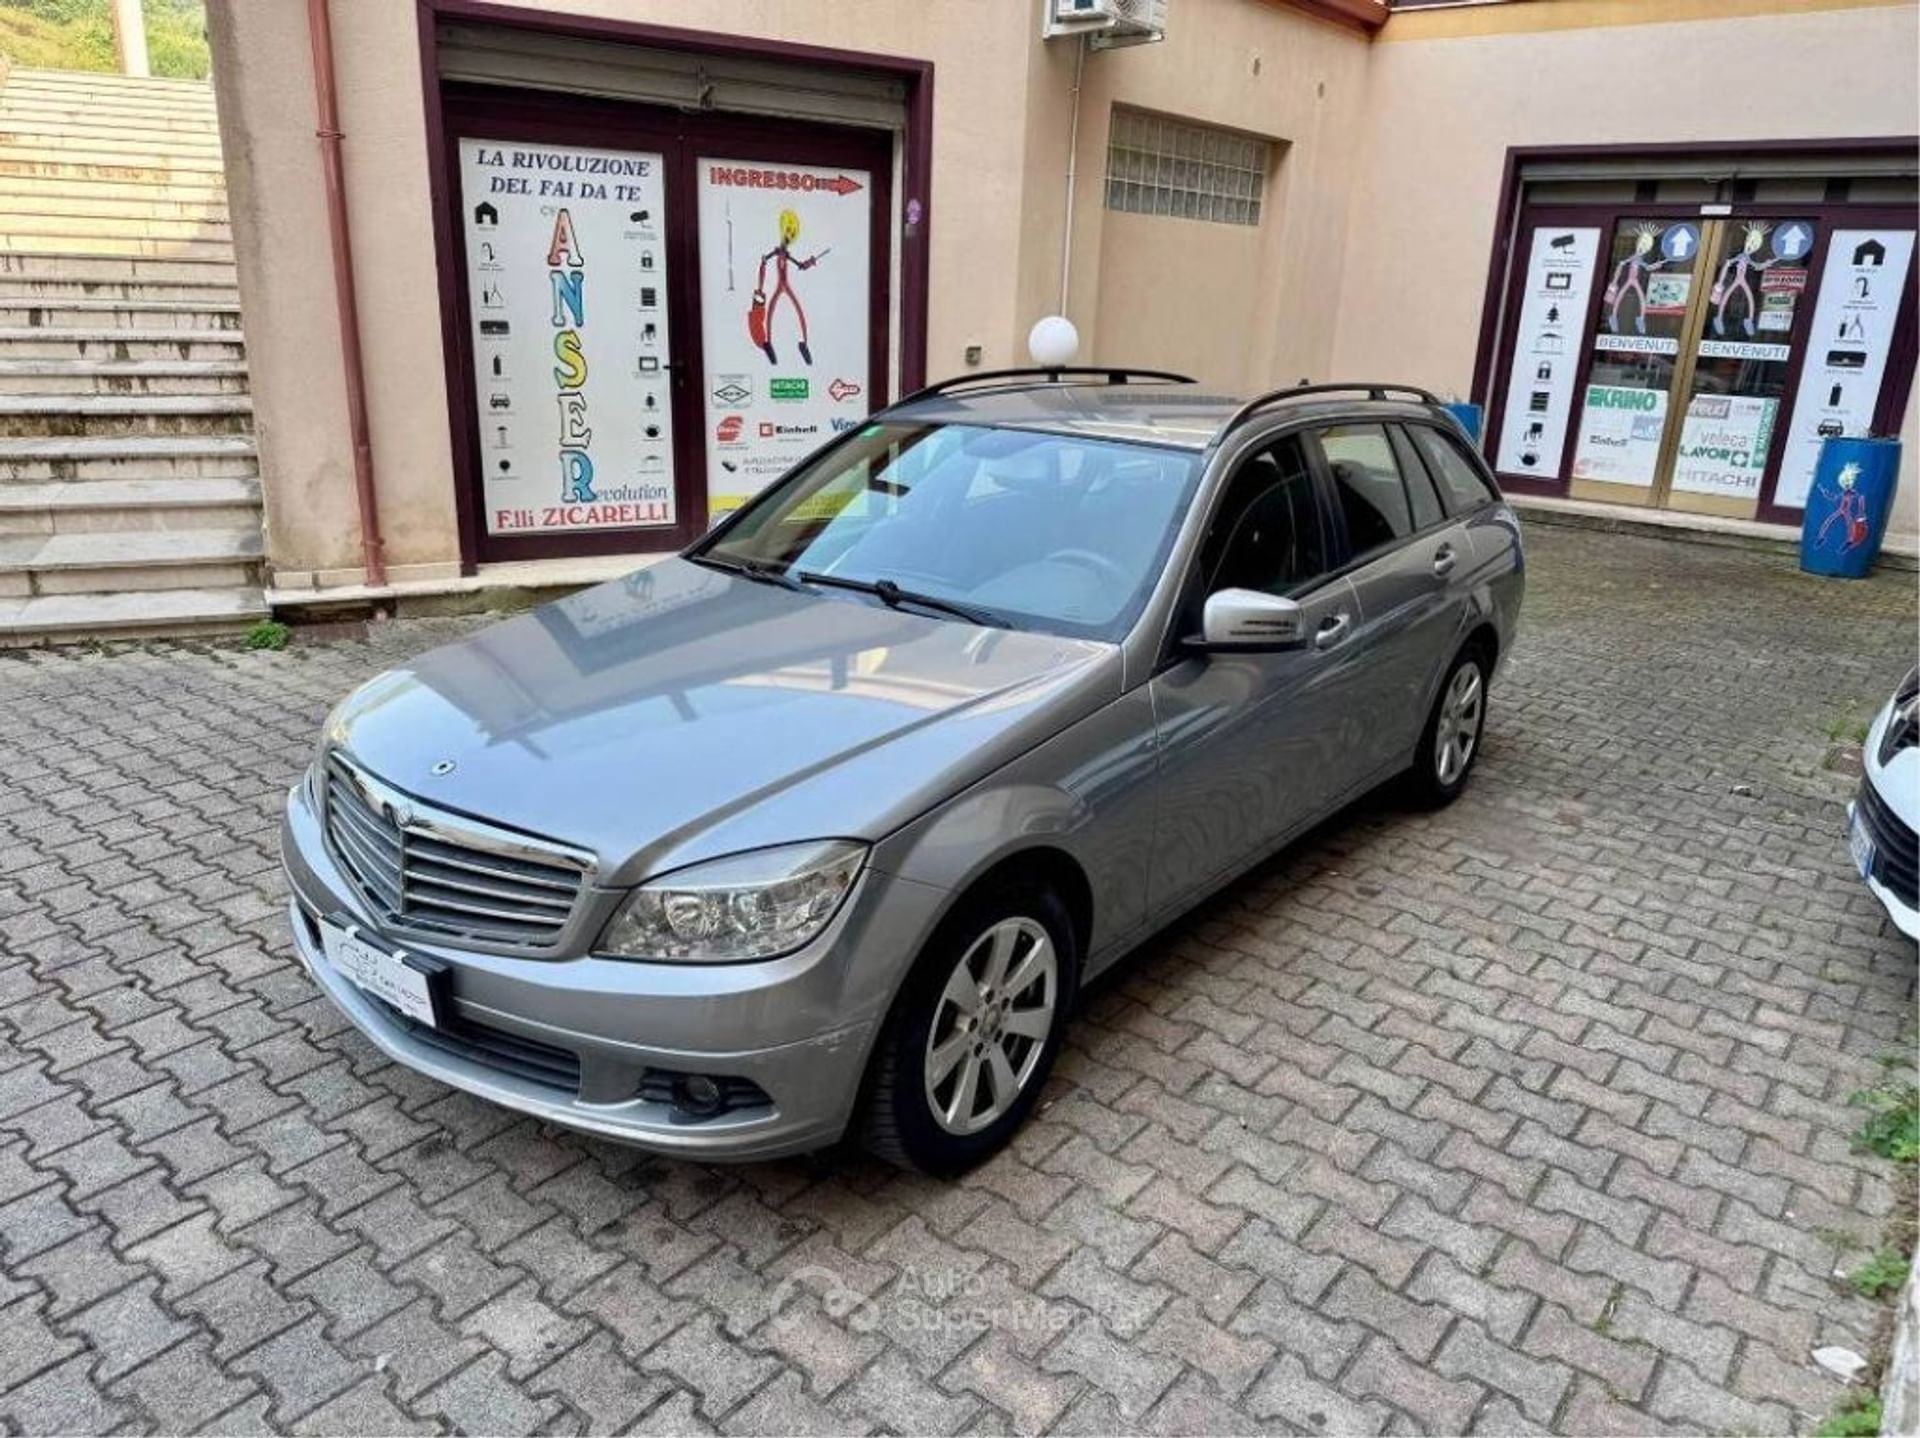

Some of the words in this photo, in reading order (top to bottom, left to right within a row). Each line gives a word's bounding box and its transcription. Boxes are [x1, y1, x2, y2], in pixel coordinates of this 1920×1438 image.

[477, 150, 504, 167] LA
[512, 152, 650, 178] RIVOLUZIONE
[490, 176, 533, 195] DEL
[539, 179, 574, 198] FAI
[580, 183, 607, 200] DA
[615, 185, 641, 201] TE
[709, 166, 816, 192] INGRESSO
[1702, 343, 1787, 359] BENVENUTI
[831, 418, 857, 432] Vir
[1679, 446, 1731, 461] LAVOR
[542, 503, 668, 526] ZICARELLI
